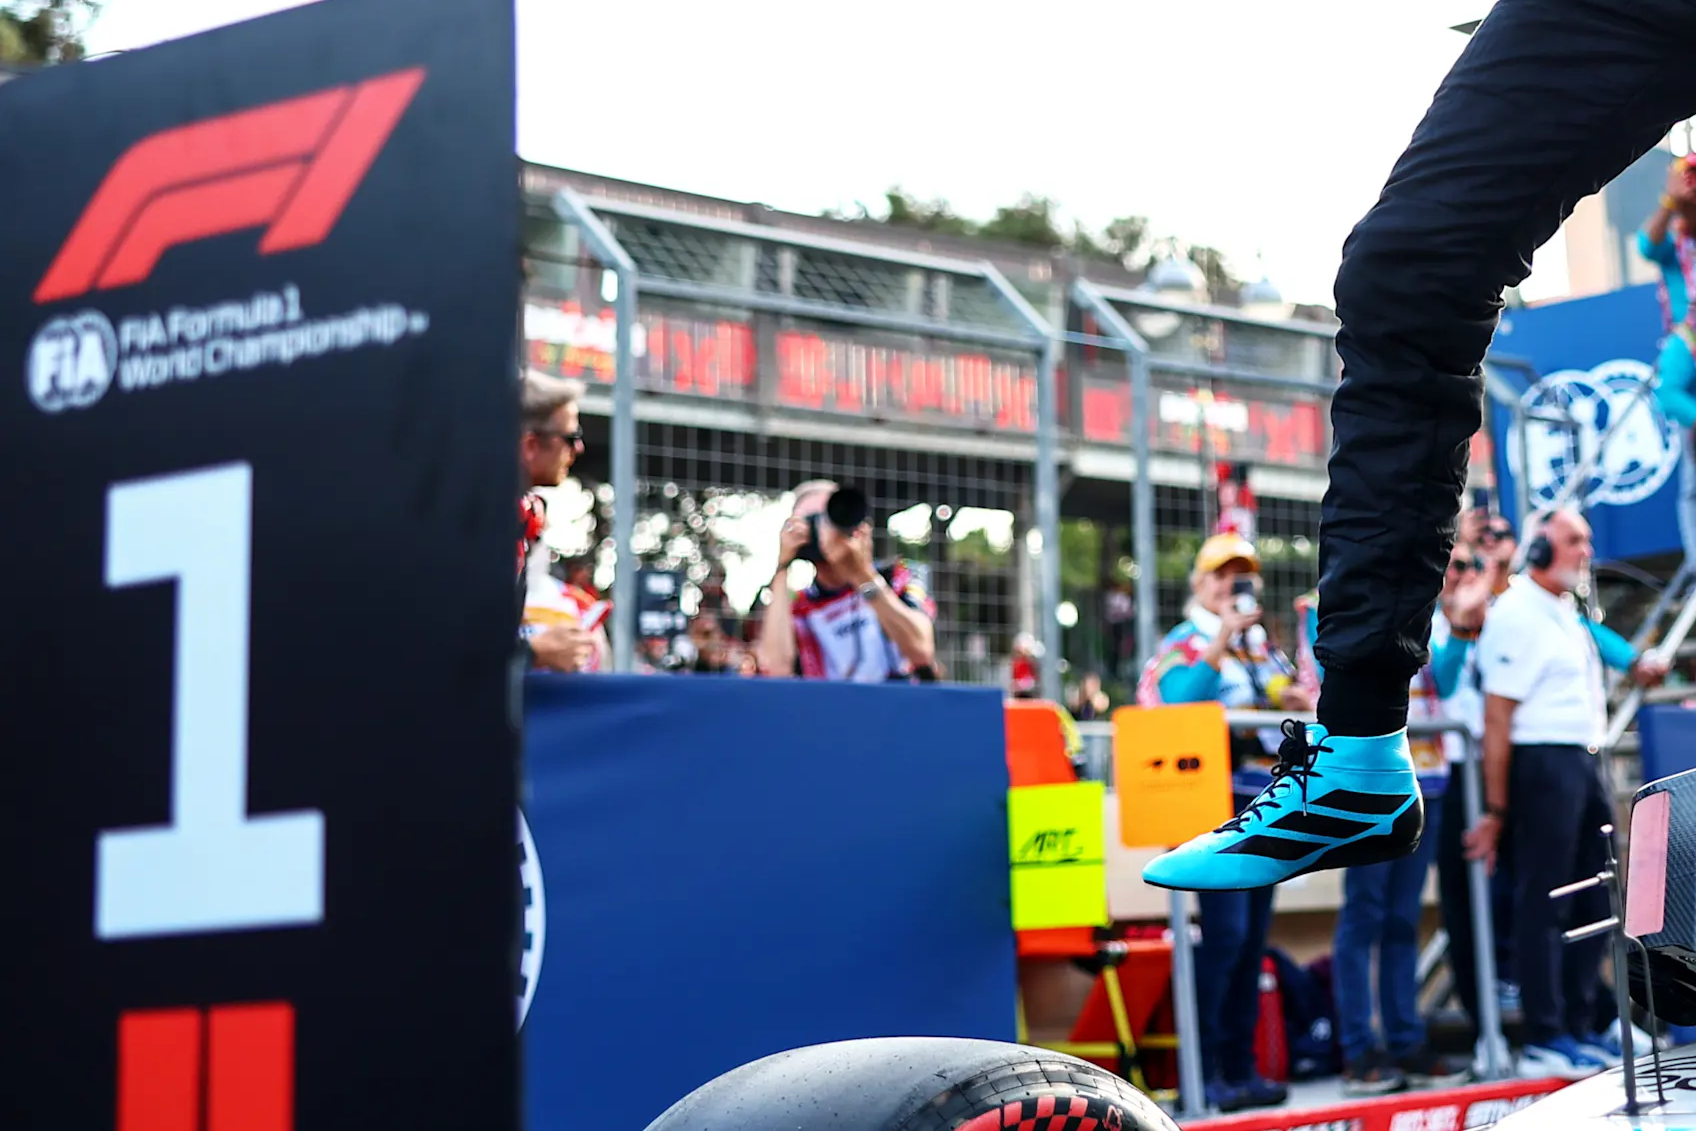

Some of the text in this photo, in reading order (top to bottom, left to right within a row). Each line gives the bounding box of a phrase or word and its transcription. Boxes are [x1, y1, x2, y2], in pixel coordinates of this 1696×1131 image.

[117, 312, 167, 350] FIA
[168, 291, 284, 345] Formula
[117, 302, 408, 391] World Championship
[29, 330, 110, 397] FIA
[95, 460, 325, 940] 1
